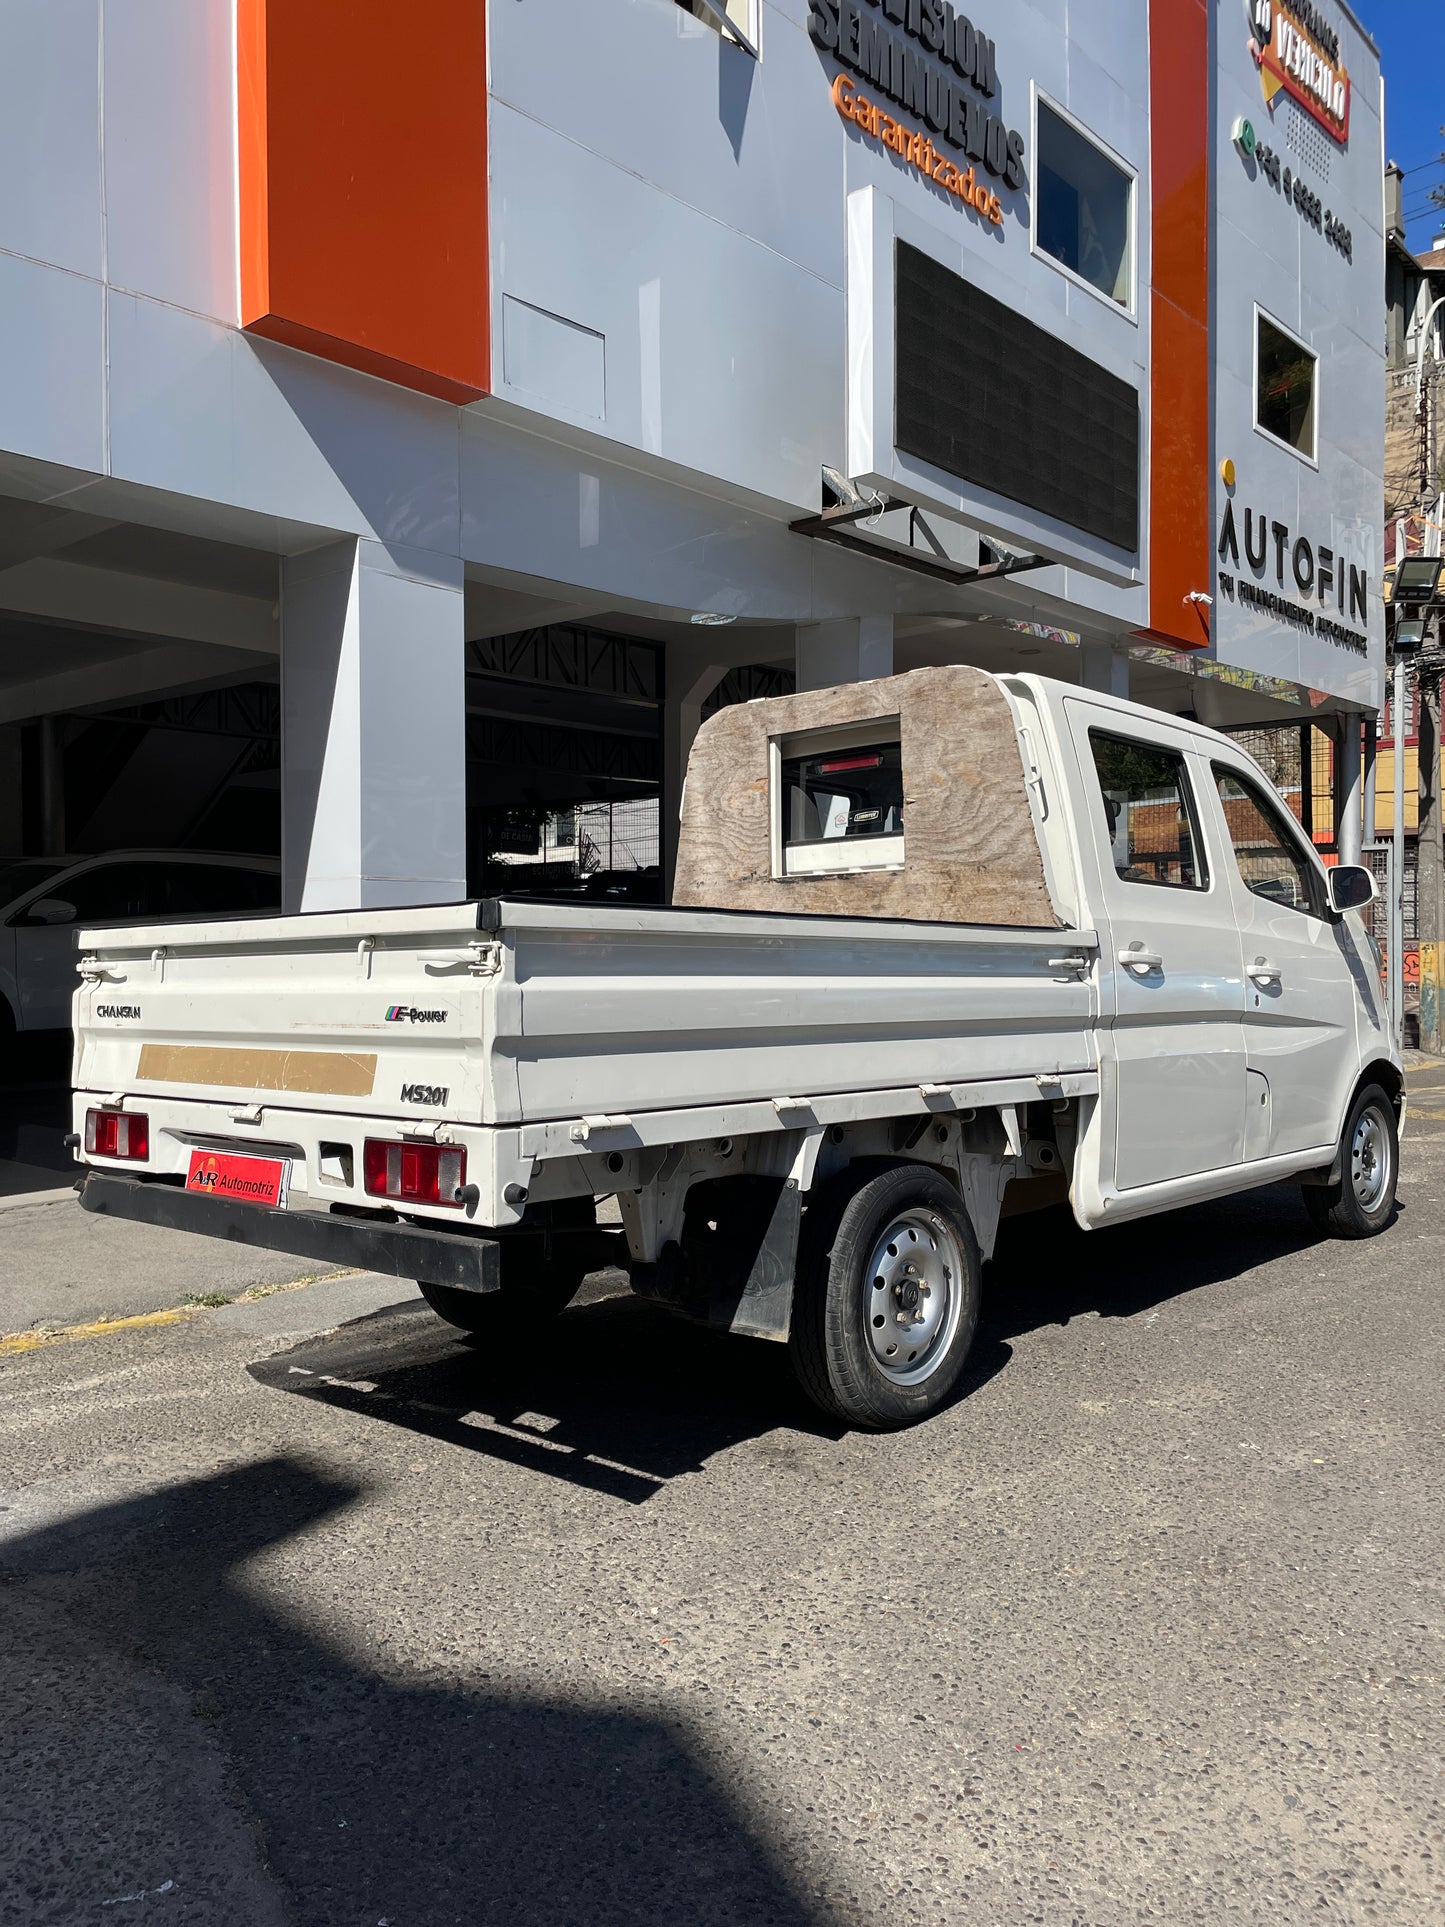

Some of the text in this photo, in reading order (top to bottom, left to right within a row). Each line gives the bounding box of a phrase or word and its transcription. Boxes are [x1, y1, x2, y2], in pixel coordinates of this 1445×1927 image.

[807, 0, 1025, 191] SEMINUEVOS
[832, 73, 1003, 225] Garantizados
[1218, 498, 1367, 619] AUTOFIN
[1238, 580, 1314, 627] FINANCIAMIENTO
[400, 1083, 450, 1107] MS201
[220, 1174, 275, 1196] Automotriz
